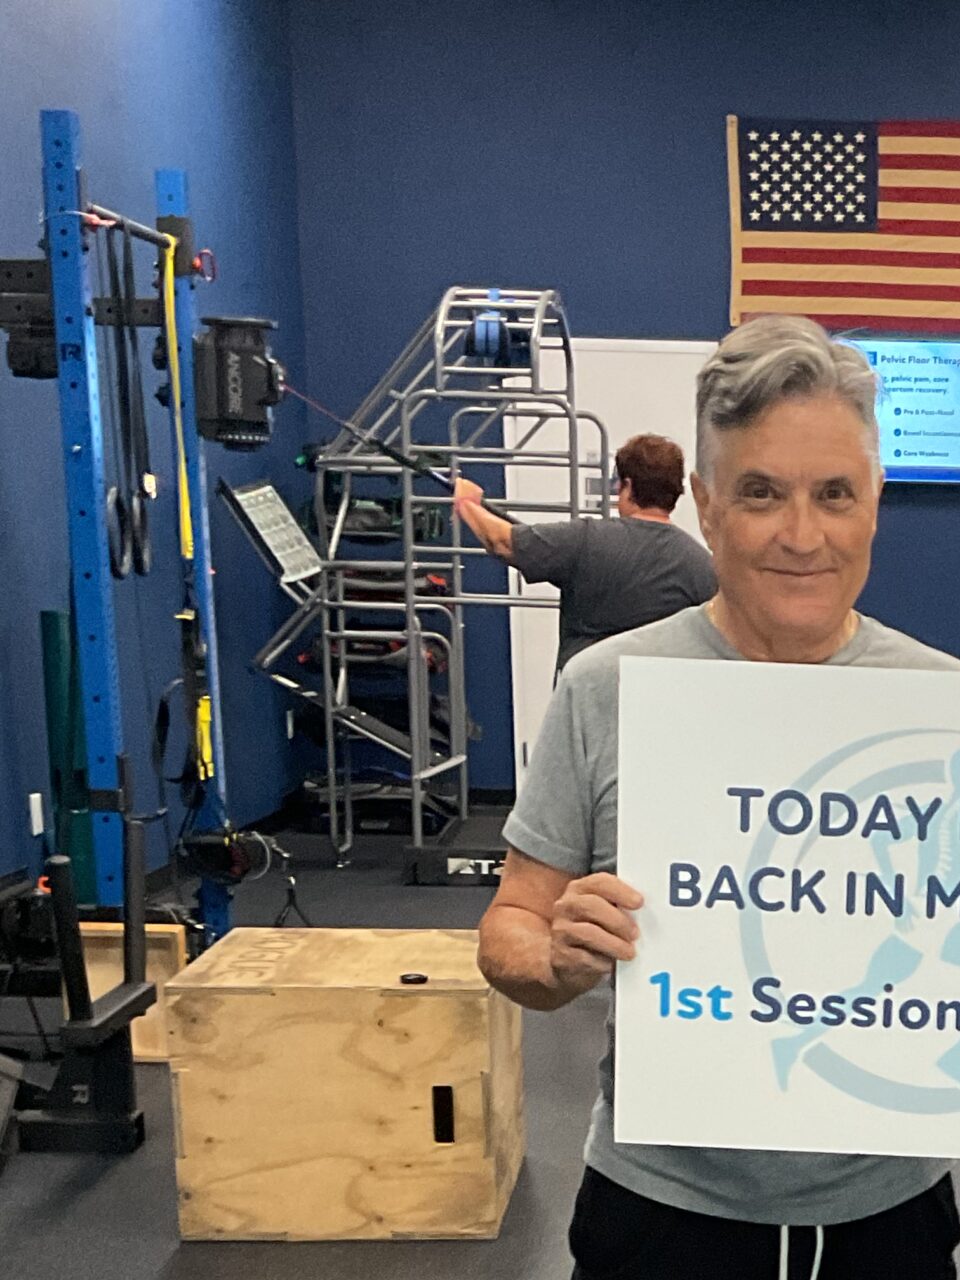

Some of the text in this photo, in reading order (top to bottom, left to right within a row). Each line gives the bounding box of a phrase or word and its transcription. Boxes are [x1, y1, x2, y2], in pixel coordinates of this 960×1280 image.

[881, 355, 906, 364] Pelvic
[908, 355, 930, 364] Floor
[728, 787, 942, 842] TODAY
[669, 863, 826, 914] BACK
[845, 871, 904, 918] IN
[649, 972, 733, 1020] 1st
